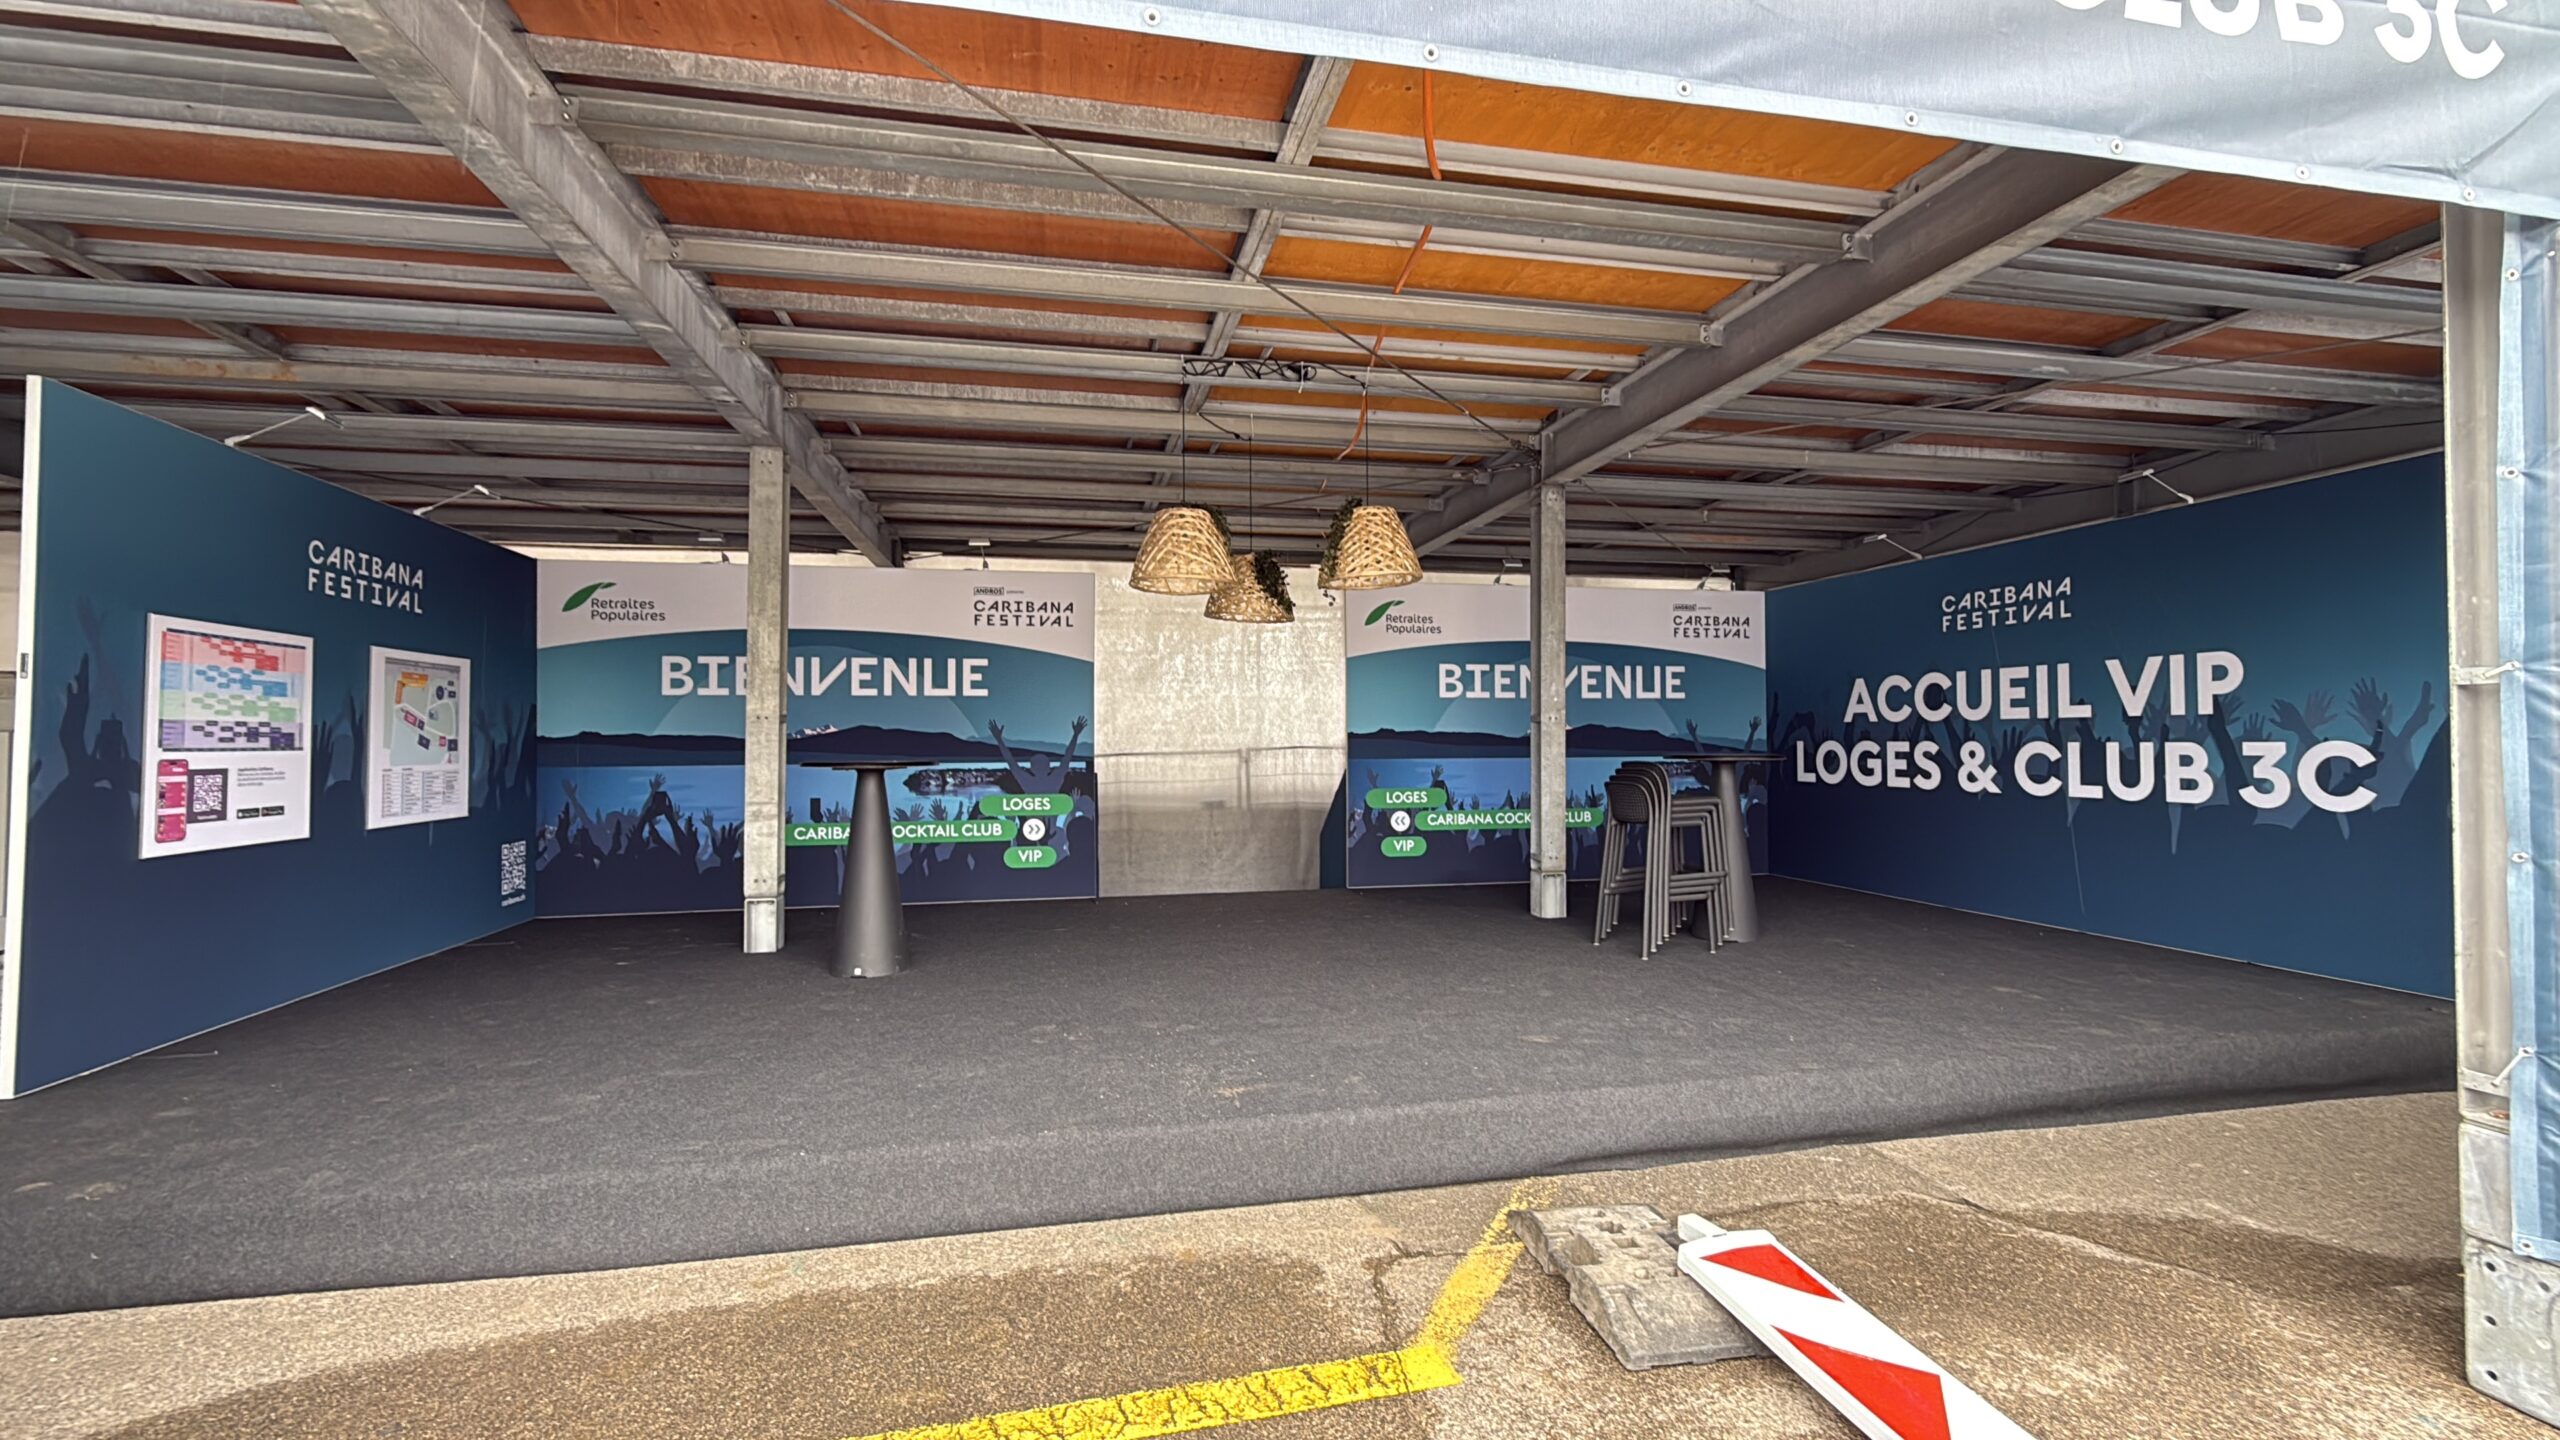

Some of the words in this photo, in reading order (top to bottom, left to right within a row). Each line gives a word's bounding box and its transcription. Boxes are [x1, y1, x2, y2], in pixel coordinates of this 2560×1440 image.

[308, 540, 423, 590] CARIBANA
[308, 567, 423, 614] FESTIVAL
[1942, 576, 2071, 613] CARIBANA
[591, 598, 655, 610] Retraites
[974, 600, 1074, 613] CARIBANA
[591, 610, 666, 622] Populaires
[974, 614, 1074, 627] FESTIVAL
[1385, 614, 1434, 624] Retraites
[1673, 615, 1750, 627] CARIBANA
[1942, 600, 2072, 632] FESTIVAL
[1385, 624, 1442, 634] Populaires
[1673, 627, 1750, 639] FESTIVAL
[1843, 663, 2092, 723] ACCUEIL
[2105, 651, 2244, 717] VIP
[1796, 740, 1941, 790] LOGES
[1957, 740, 2002, 794] &
[2014, 740, 2214, 805] CLUB
[2238, 740, 2378, 813] 3C
[1002, 797, 1051, 811] LOGES
[1386, 791, 1428, 804] LOGES
[1427, 813, 1493, 826] CARIBANA
[1495, 812, 1531, 824] COCK
[793, 825, 851, 840] CARIBA
[892, 823, 958, 838] OCKTAIL
[961, 821, 1003, 837] CLUB
[1393, 840, 1415, 852] VIP
[1018, 850, 1043, 863] VIP
